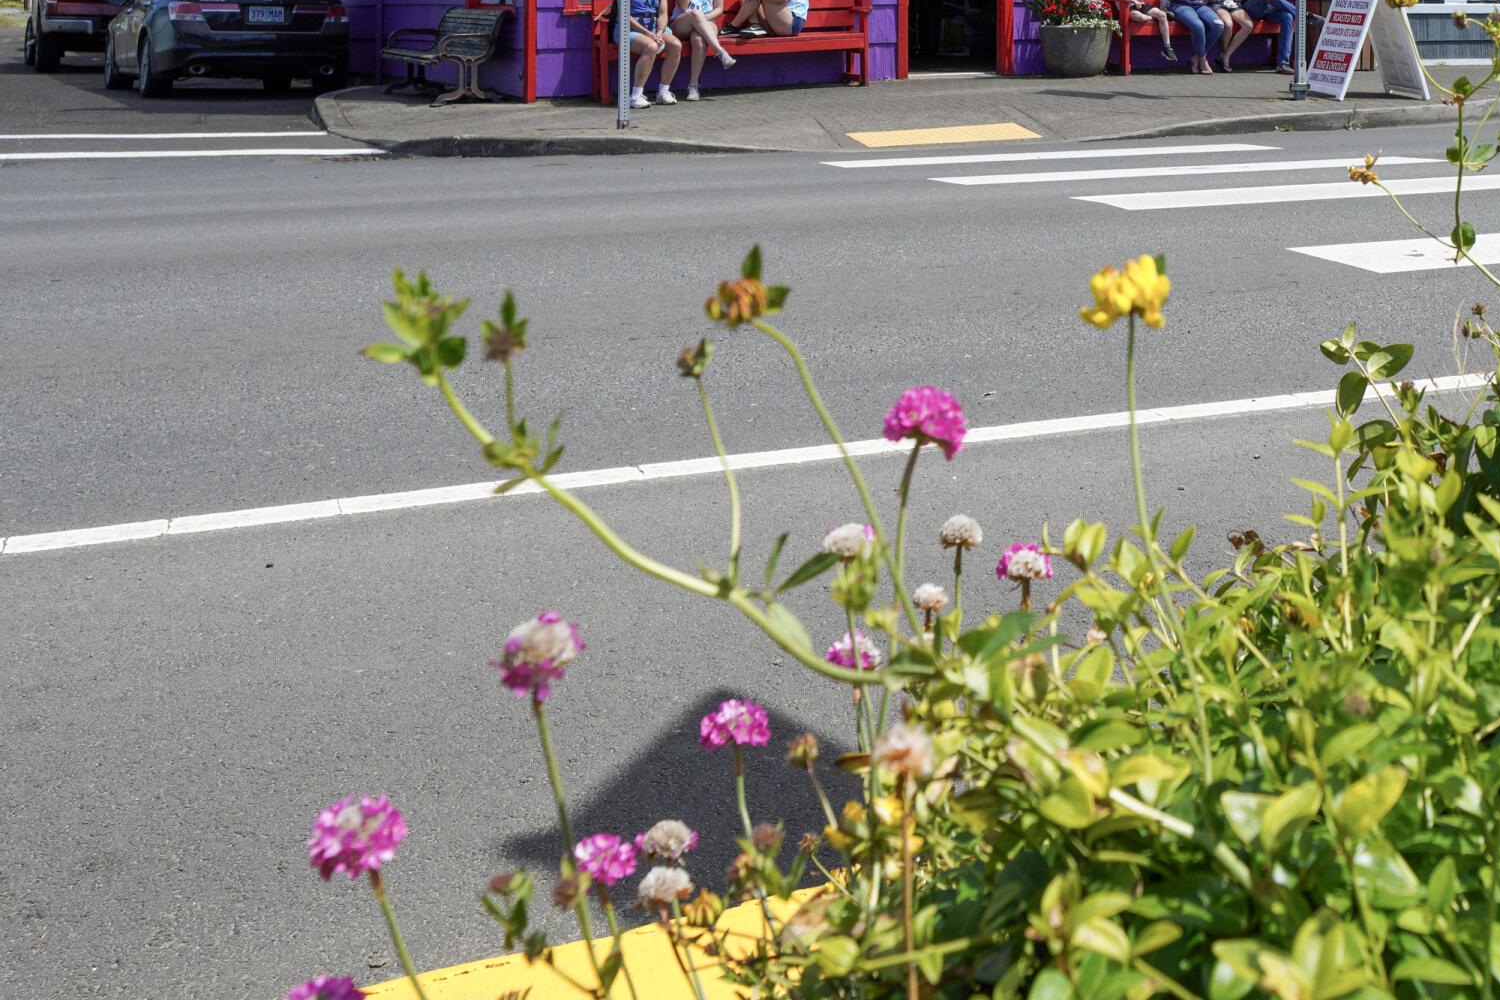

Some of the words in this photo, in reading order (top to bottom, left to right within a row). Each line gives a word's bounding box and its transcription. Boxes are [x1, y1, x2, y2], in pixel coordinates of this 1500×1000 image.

[1335, 0, 1346, 8] MADE
[1347, 0, 1351, 8] IN
[1352, 0, 1369, 9] OREGON
[1333, 13, 1350, 23] ROASTED
[1351, 14, 1362, 23] NUTS
[1325, 26, 1344, 36] TILLAMOOK
[1322, 52, 1347, 61] HOMEMADE
